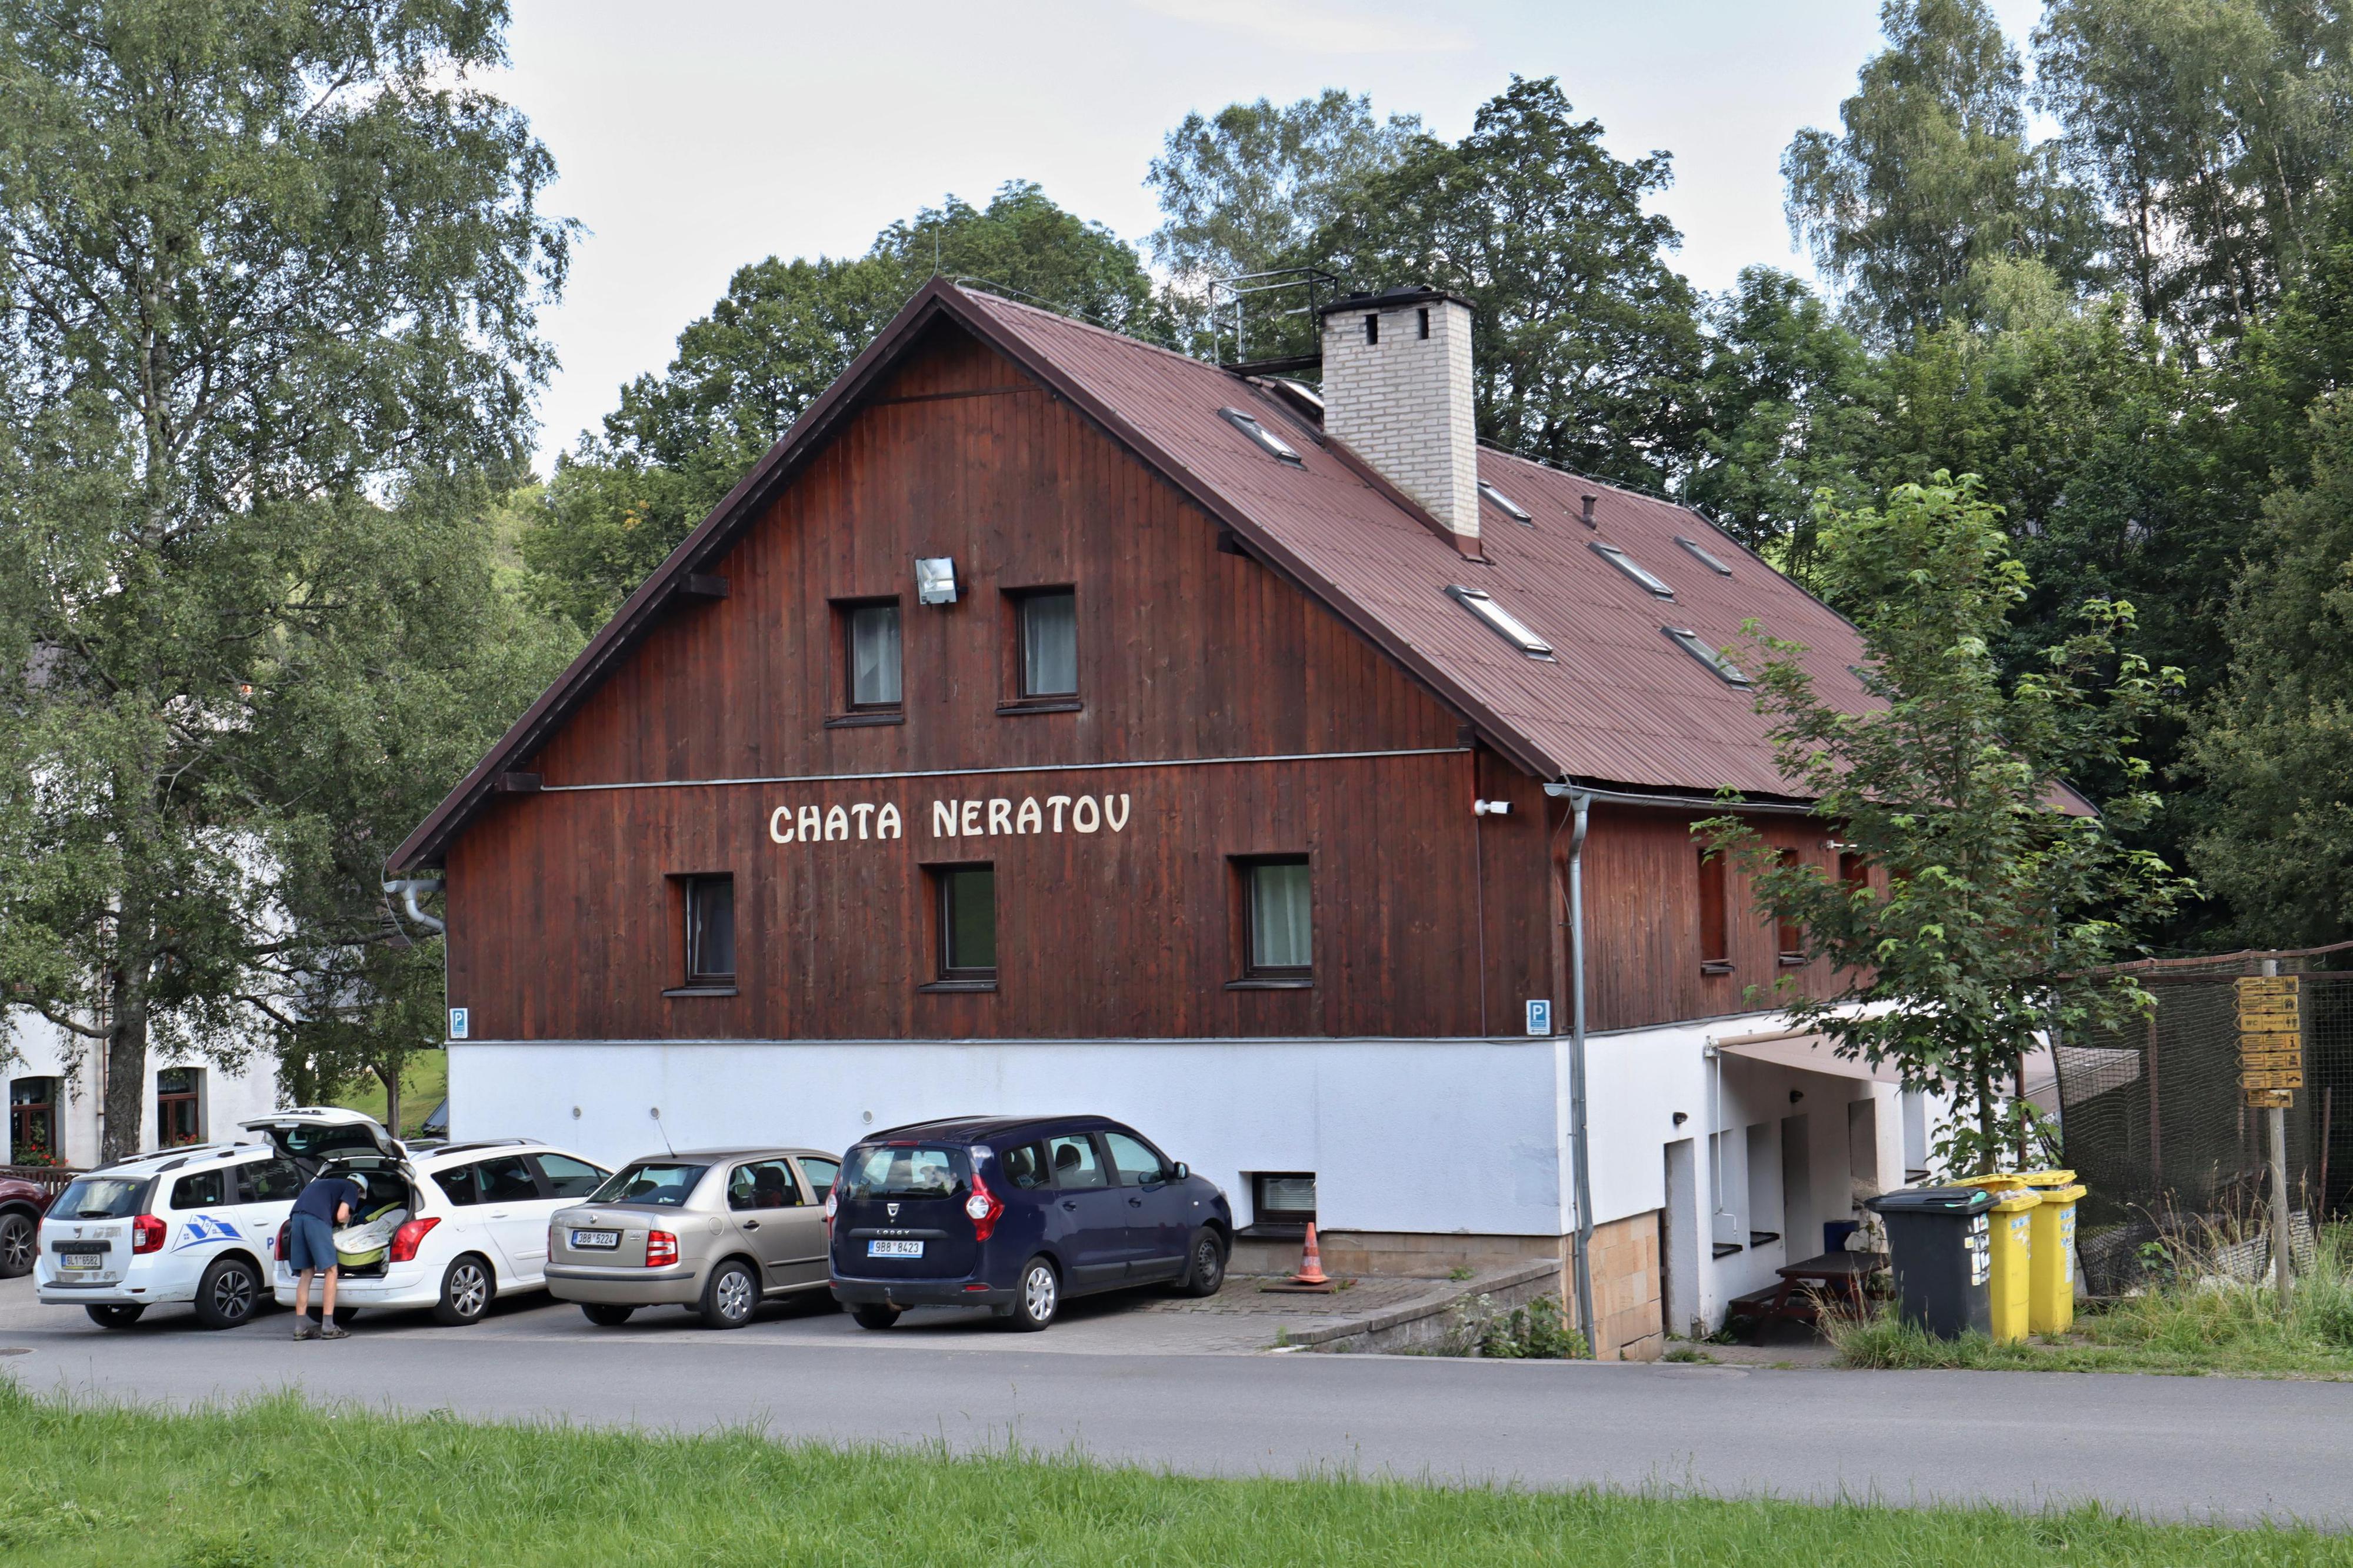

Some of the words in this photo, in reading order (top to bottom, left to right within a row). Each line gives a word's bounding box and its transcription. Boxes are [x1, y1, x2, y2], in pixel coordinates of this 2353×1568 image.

[769, 802, 902, 844] CHATA
[933, 793, 1130, 838] NERATOV
[455, 1012, 463, 1026] P
[1532, 1005, 1544, 1020] P
[578, 1233, 592, 1243] 3B8
[596, 1234, 613, 1245] 5224
[875, 1242, 891, 1252] 9B8
[897, 1242, 919, 1253] 8423
[66, 1256, 78, 1265] 6L1
[82, 1256, 98, 1265] 6582
